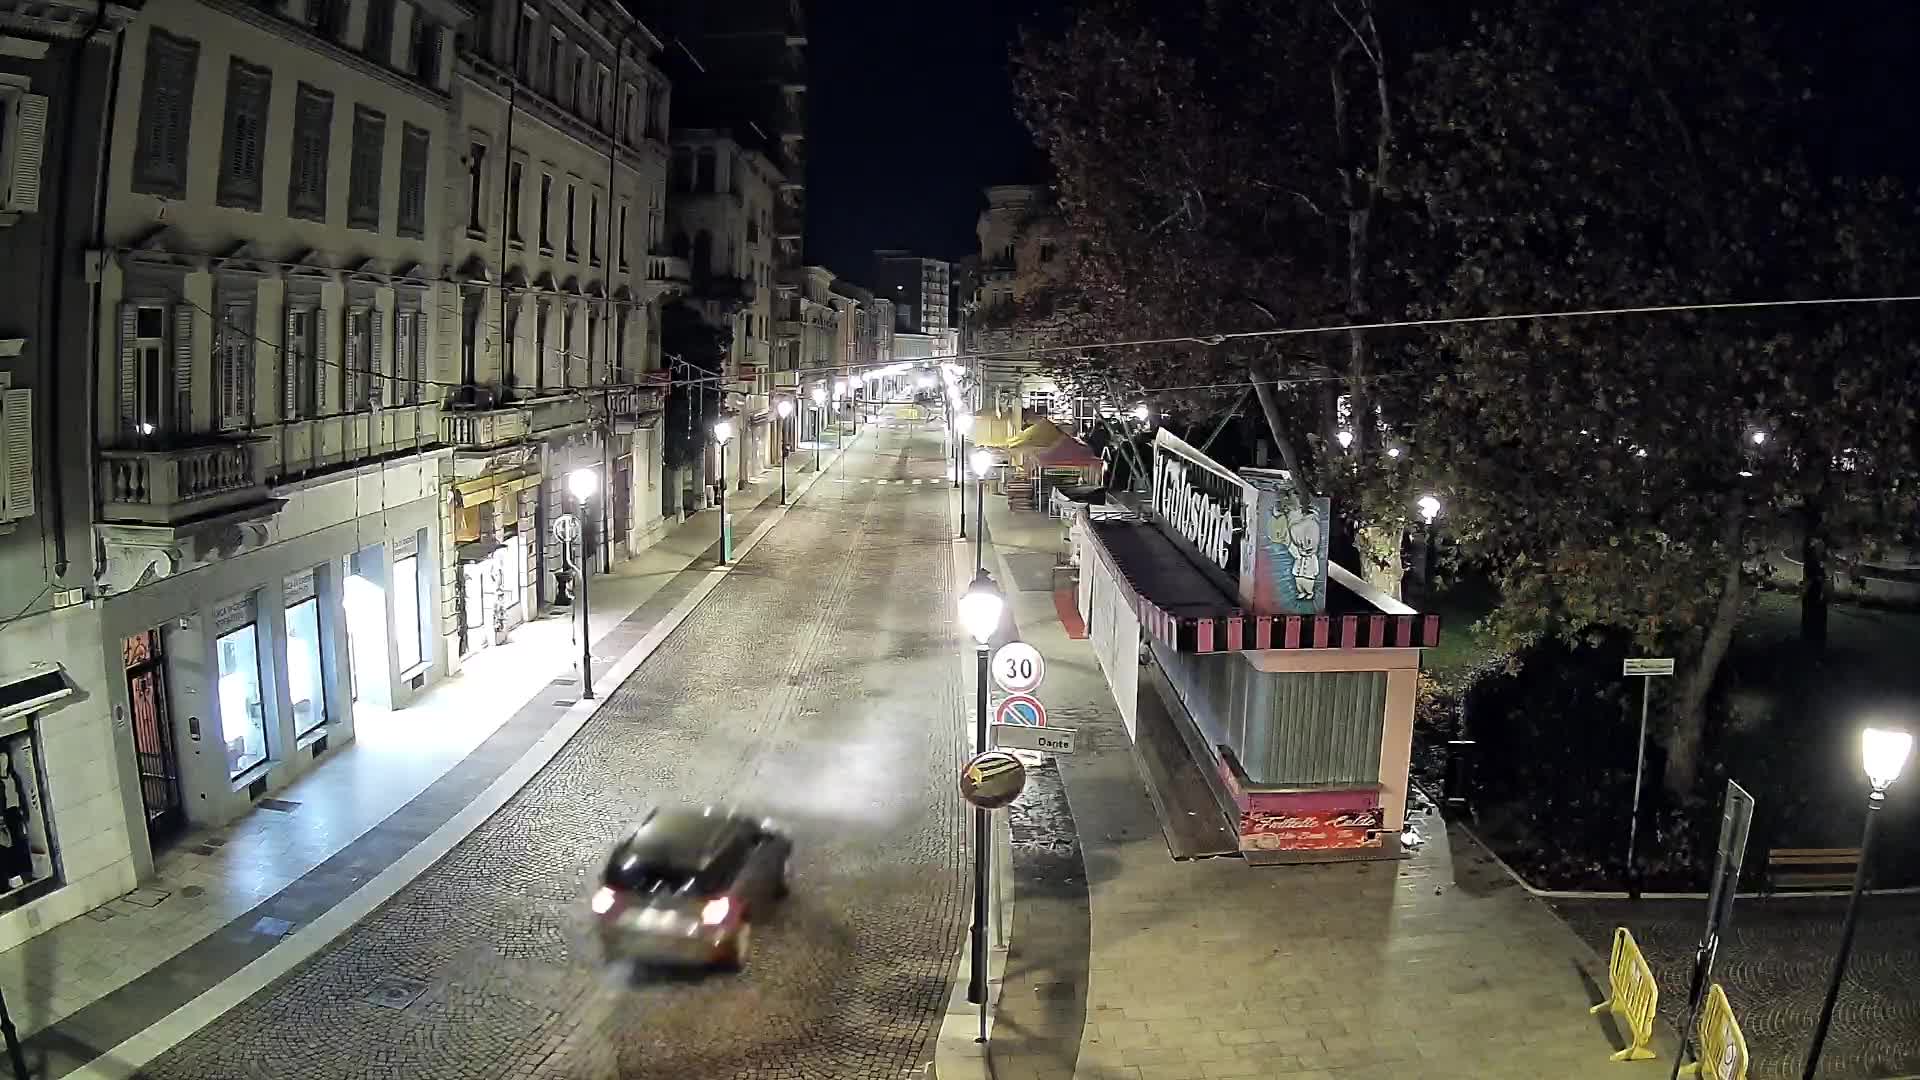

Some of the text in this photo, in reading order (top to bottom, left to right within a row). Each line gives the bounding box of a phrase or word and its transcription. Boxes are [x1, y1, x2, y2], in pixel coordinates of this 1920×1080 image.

[1162, 458, 1233, 570] Golosone
[1006, 658, 1032, 679] 30
[1038, 737, 1069, 749] Dante
